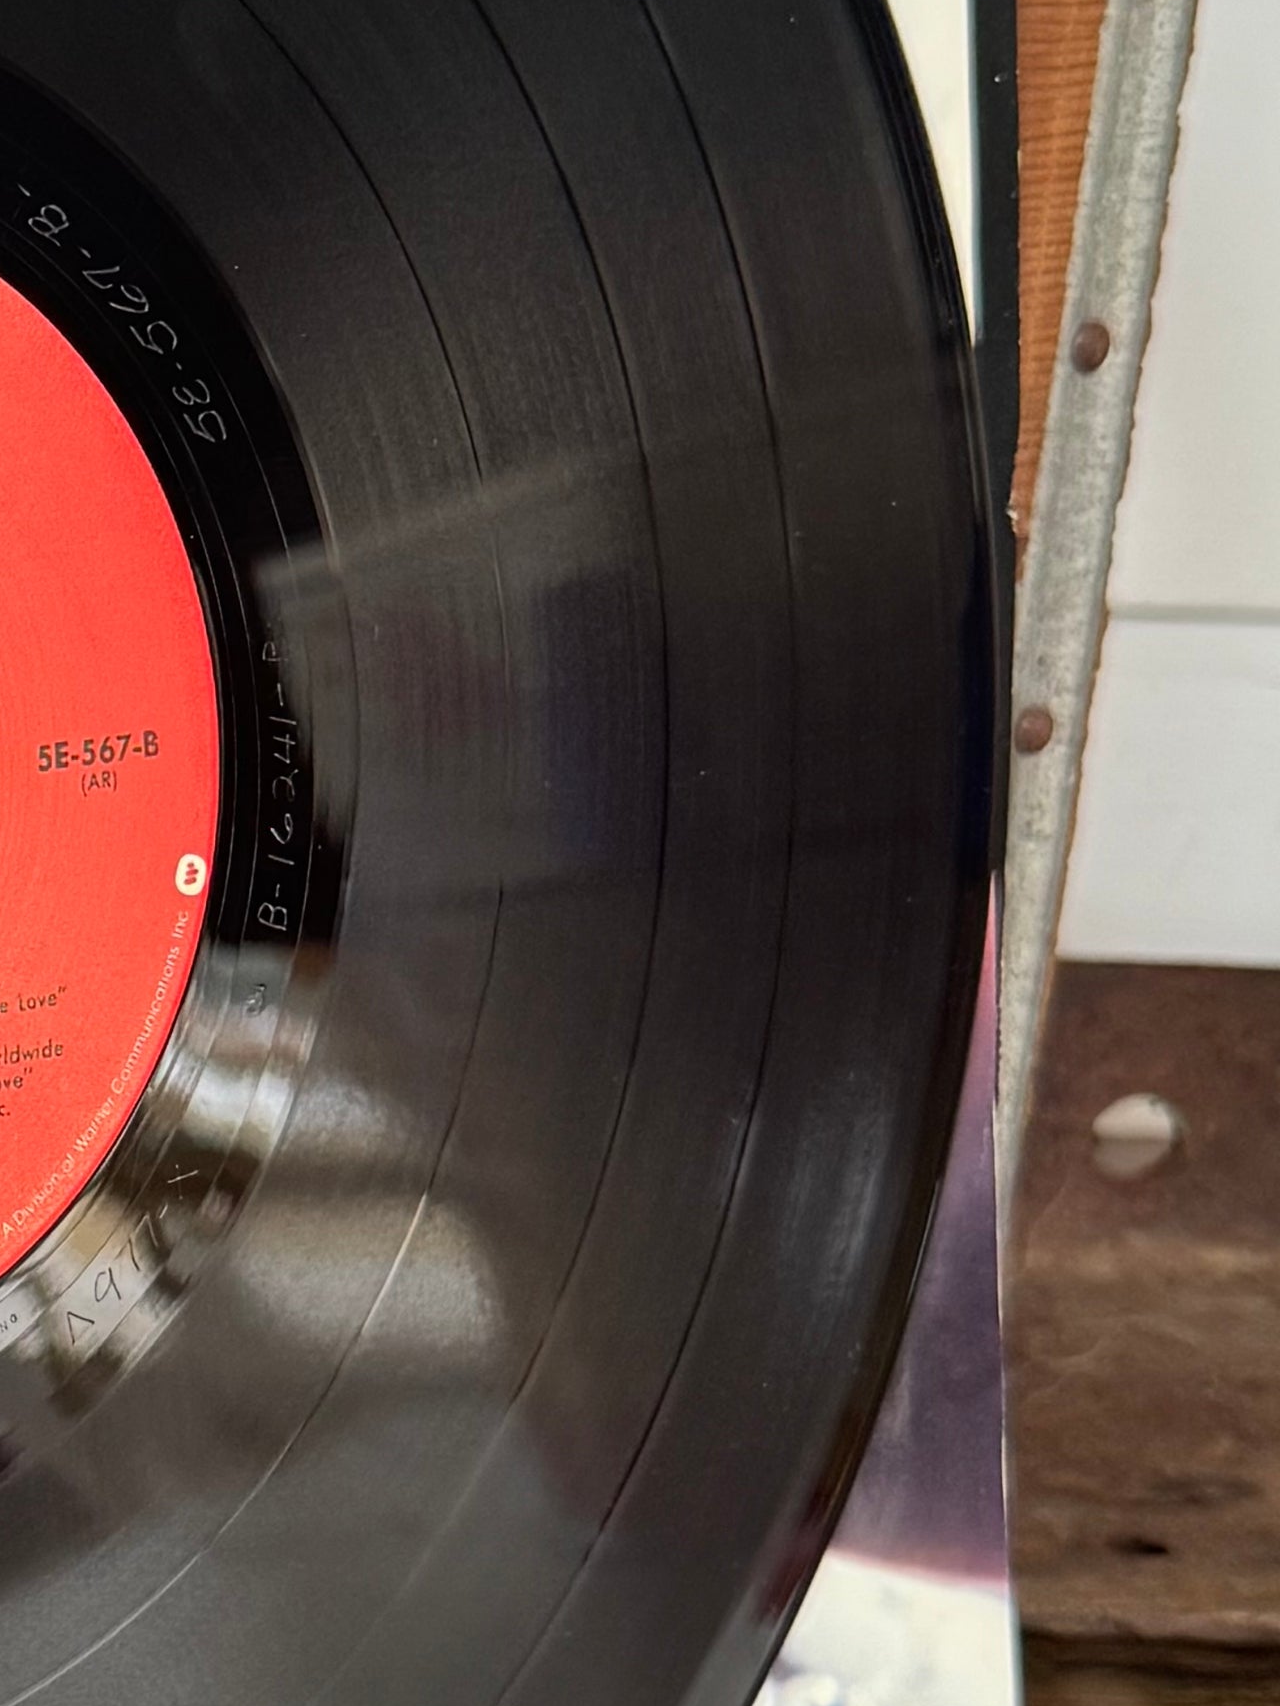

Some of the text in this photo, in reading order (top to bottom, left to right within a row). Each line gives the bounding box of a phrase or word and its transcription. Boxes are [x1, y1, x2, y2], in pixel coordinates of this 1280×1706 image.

[38, 730, 158, 772] 5E-567-B
[82, 770, 117, 797] (AR)
[18, 986, 67, 1012] Love"
